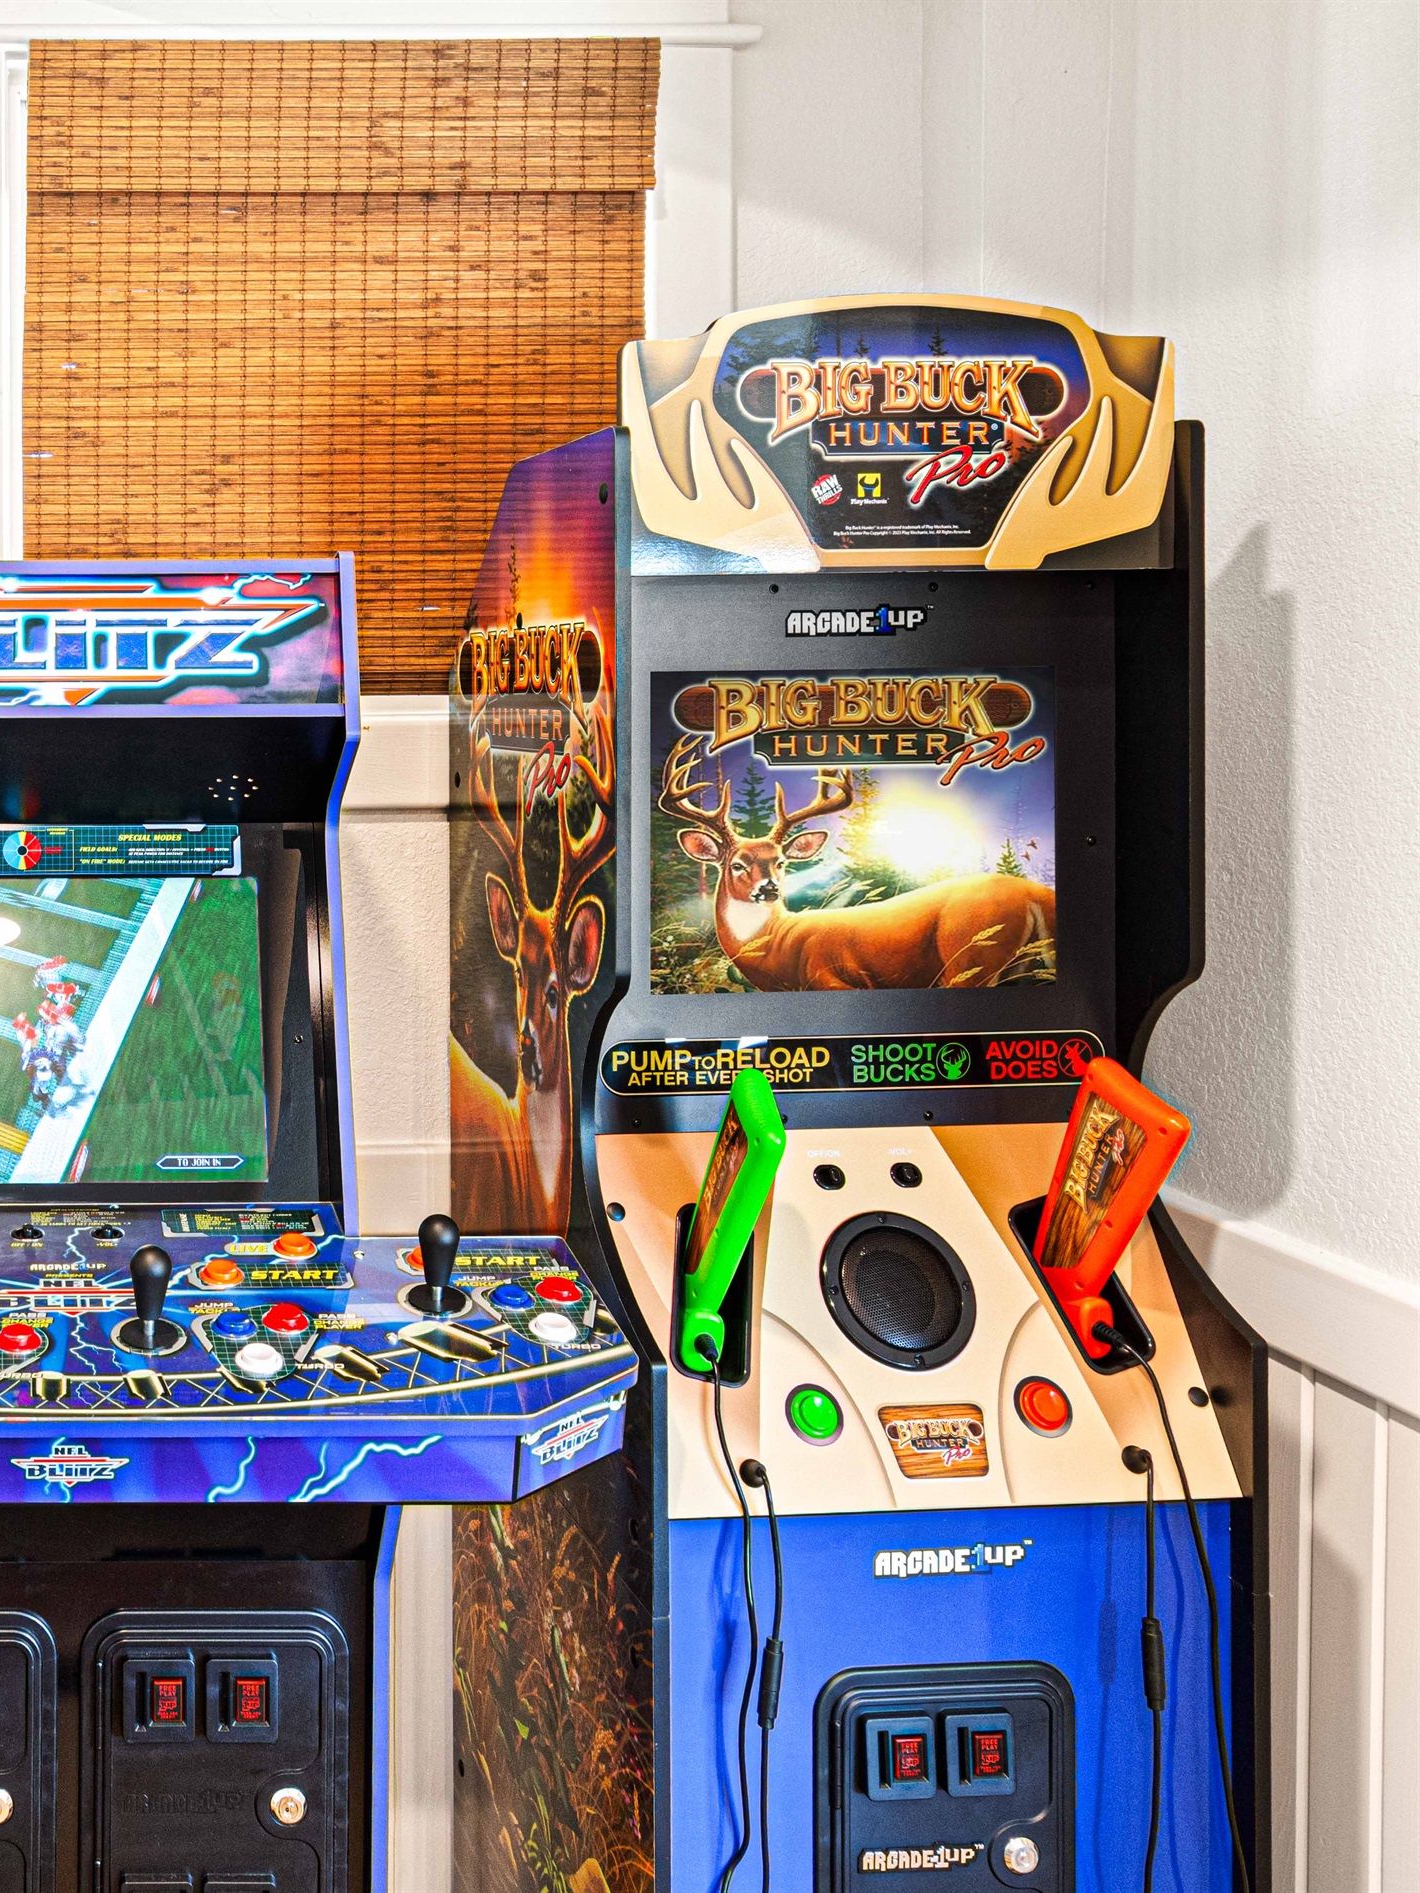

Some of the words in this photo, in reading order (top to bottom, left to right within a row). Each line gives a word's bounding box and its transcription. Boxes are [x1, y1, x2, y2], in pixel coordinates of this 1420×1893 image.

[771, 362, 872, 443] BIG
[882, 359, 1039, 439] BUCK
[907, 446, 1007, 504] Pro
[811, 474, 840, 499] RAW
[816, 485, 843, 504] THRILLS
[469, 629, 510, 731] BIG
[513, 622, 588, 735] BUCK
[491, 707, 564, 741] HUNTER
[708, 678, 822, 754] BIG
[829, 677, 998, 735] BUCK
[772, 733, 950, 757] HUNTER
[936, 730, 1046, 786] Pro
[523, 741, 571, 817] Pro
[611, 1049, 692, 1072] PUMP
[716, 1047, 831, 1070] RELOAD
[850, 1043, 937, 1064] SHOOT
[985, 1039, 1058, 1061] AVOID
[628, 1071, 689, 1087] AFTER
[696, 1070, 741, 1085] EVE
[763, 1068, 814, 1083] SHOT
[853, 1063, 936, 1083] BUCKS
[990, 1060, 1058, 1080] DOES
[177, 1158, 189, 1167] TO
[190, 1158, 210, 1167] JOIN
[212, 1158, 222, 1167] IN
[1064, 1155, 1090, 1214] BIG
[1079, 1099, 1120, 1167] BUCK
[1087, 1133, 1115, 1194] HUNTER
[454, 1256, 541, 1266] START
[41, 1280, 96, 1288] NFL
[250, 1270, 339, 1281] START
[560, 1417, 583, 1432] NFL
[894, 1421, 928, 1446] BIG
[928, 1420, 979, 1444] BUCK
[54, 1447, 88, 1456] NFL
[540, 1428, 599, 1464] BLITZ
[916, 1438, 965, 1448] HUNTER
[942, 1446, 971, 1466] Pro
[26, 1464, 114, 1478] BLITZ
